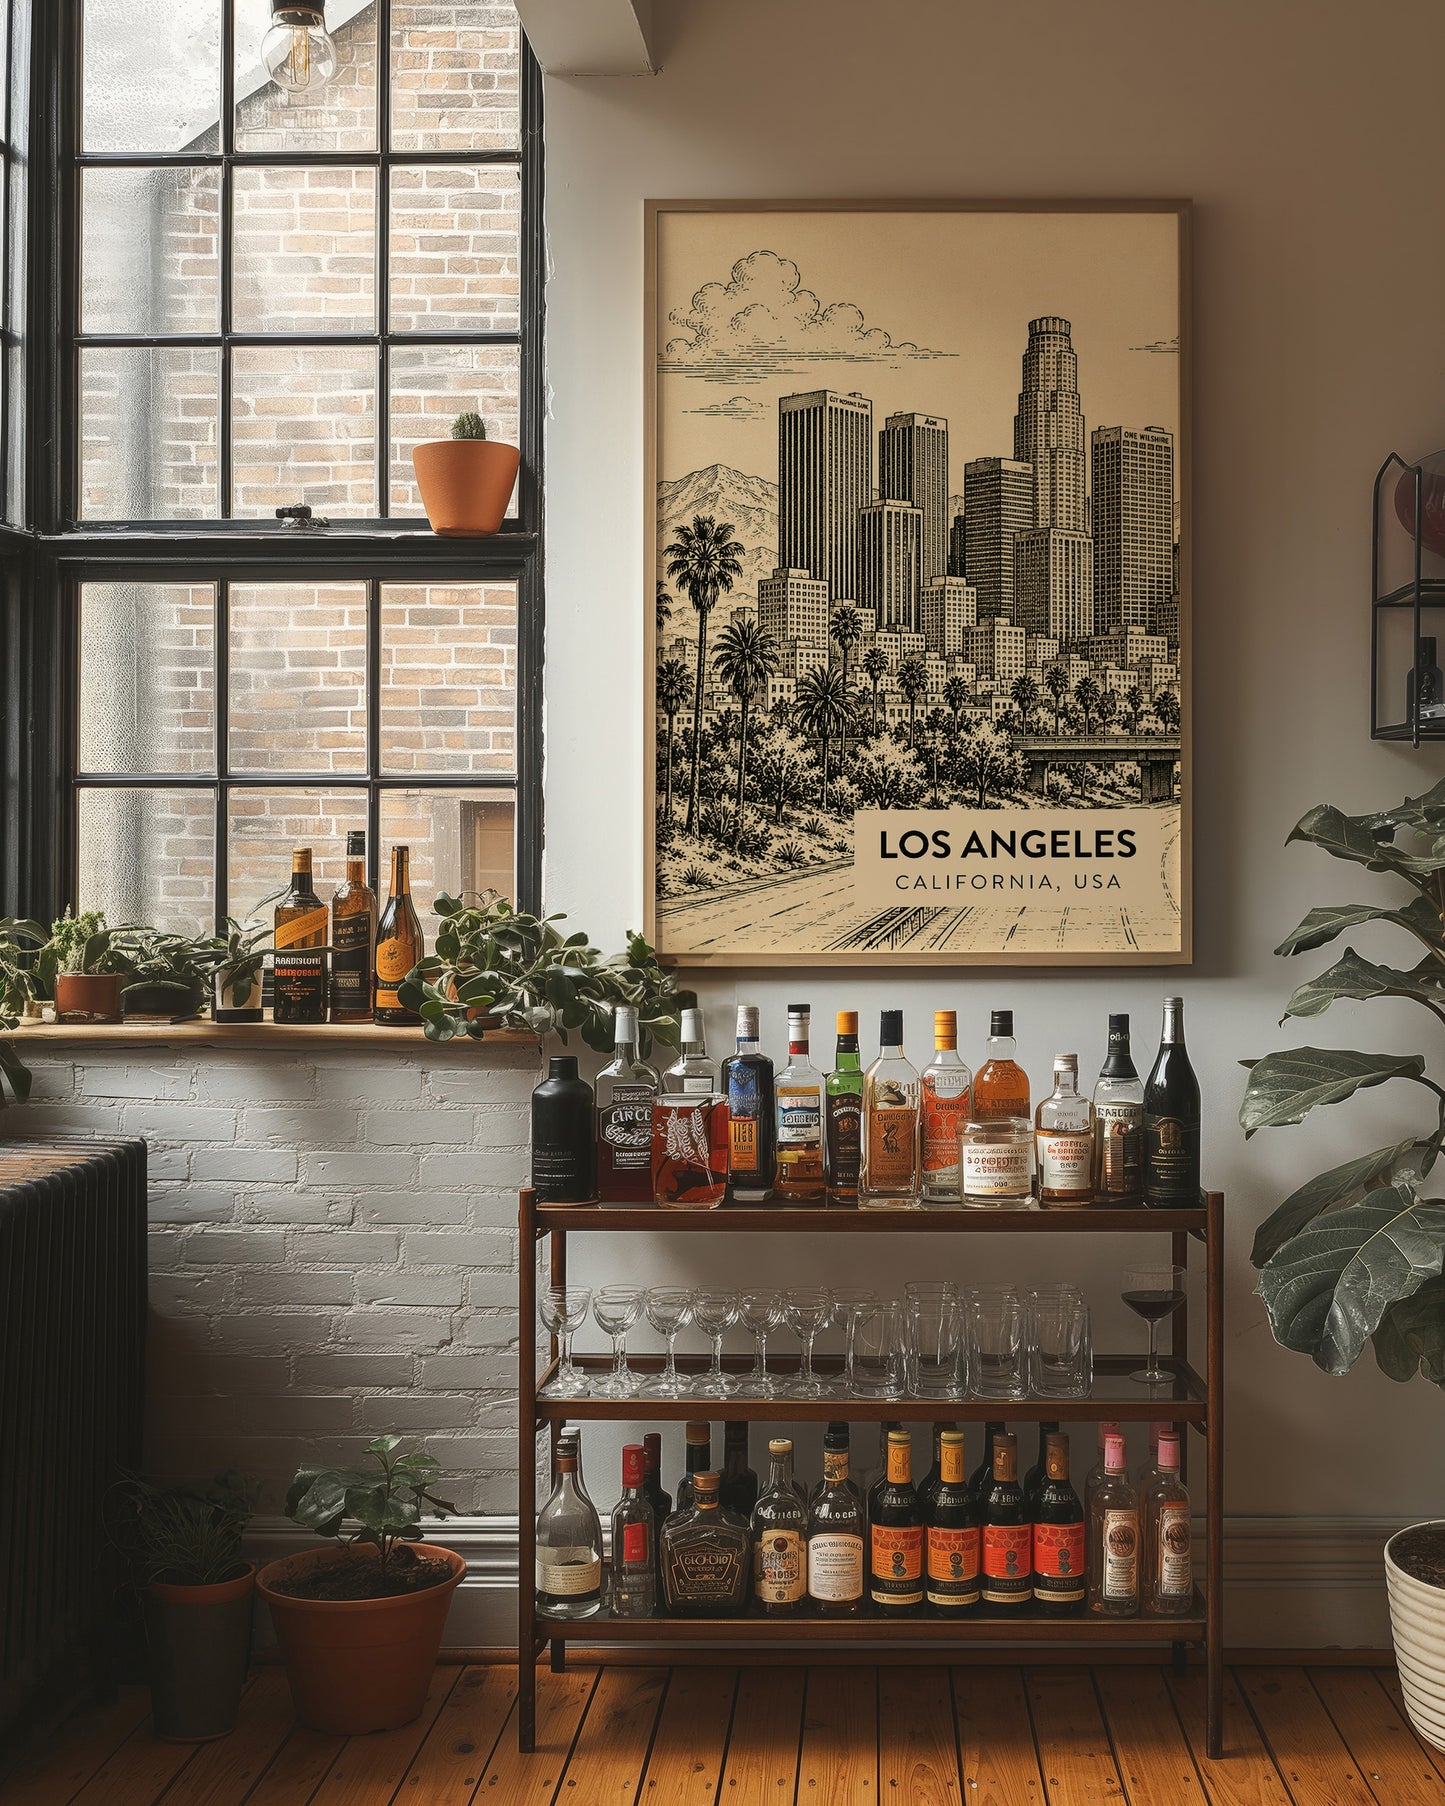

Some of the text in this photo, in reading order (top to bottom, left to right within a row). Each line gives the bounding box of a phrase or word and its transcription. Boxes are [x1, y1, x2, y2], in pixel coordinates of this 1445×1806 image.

[1123, 431, 1170, 445] ONE WILSHIRE
[880, 829, 1137, 859] LOS ANGELES
[895, 873, 1121, 893] CALIFORNIA, USA
